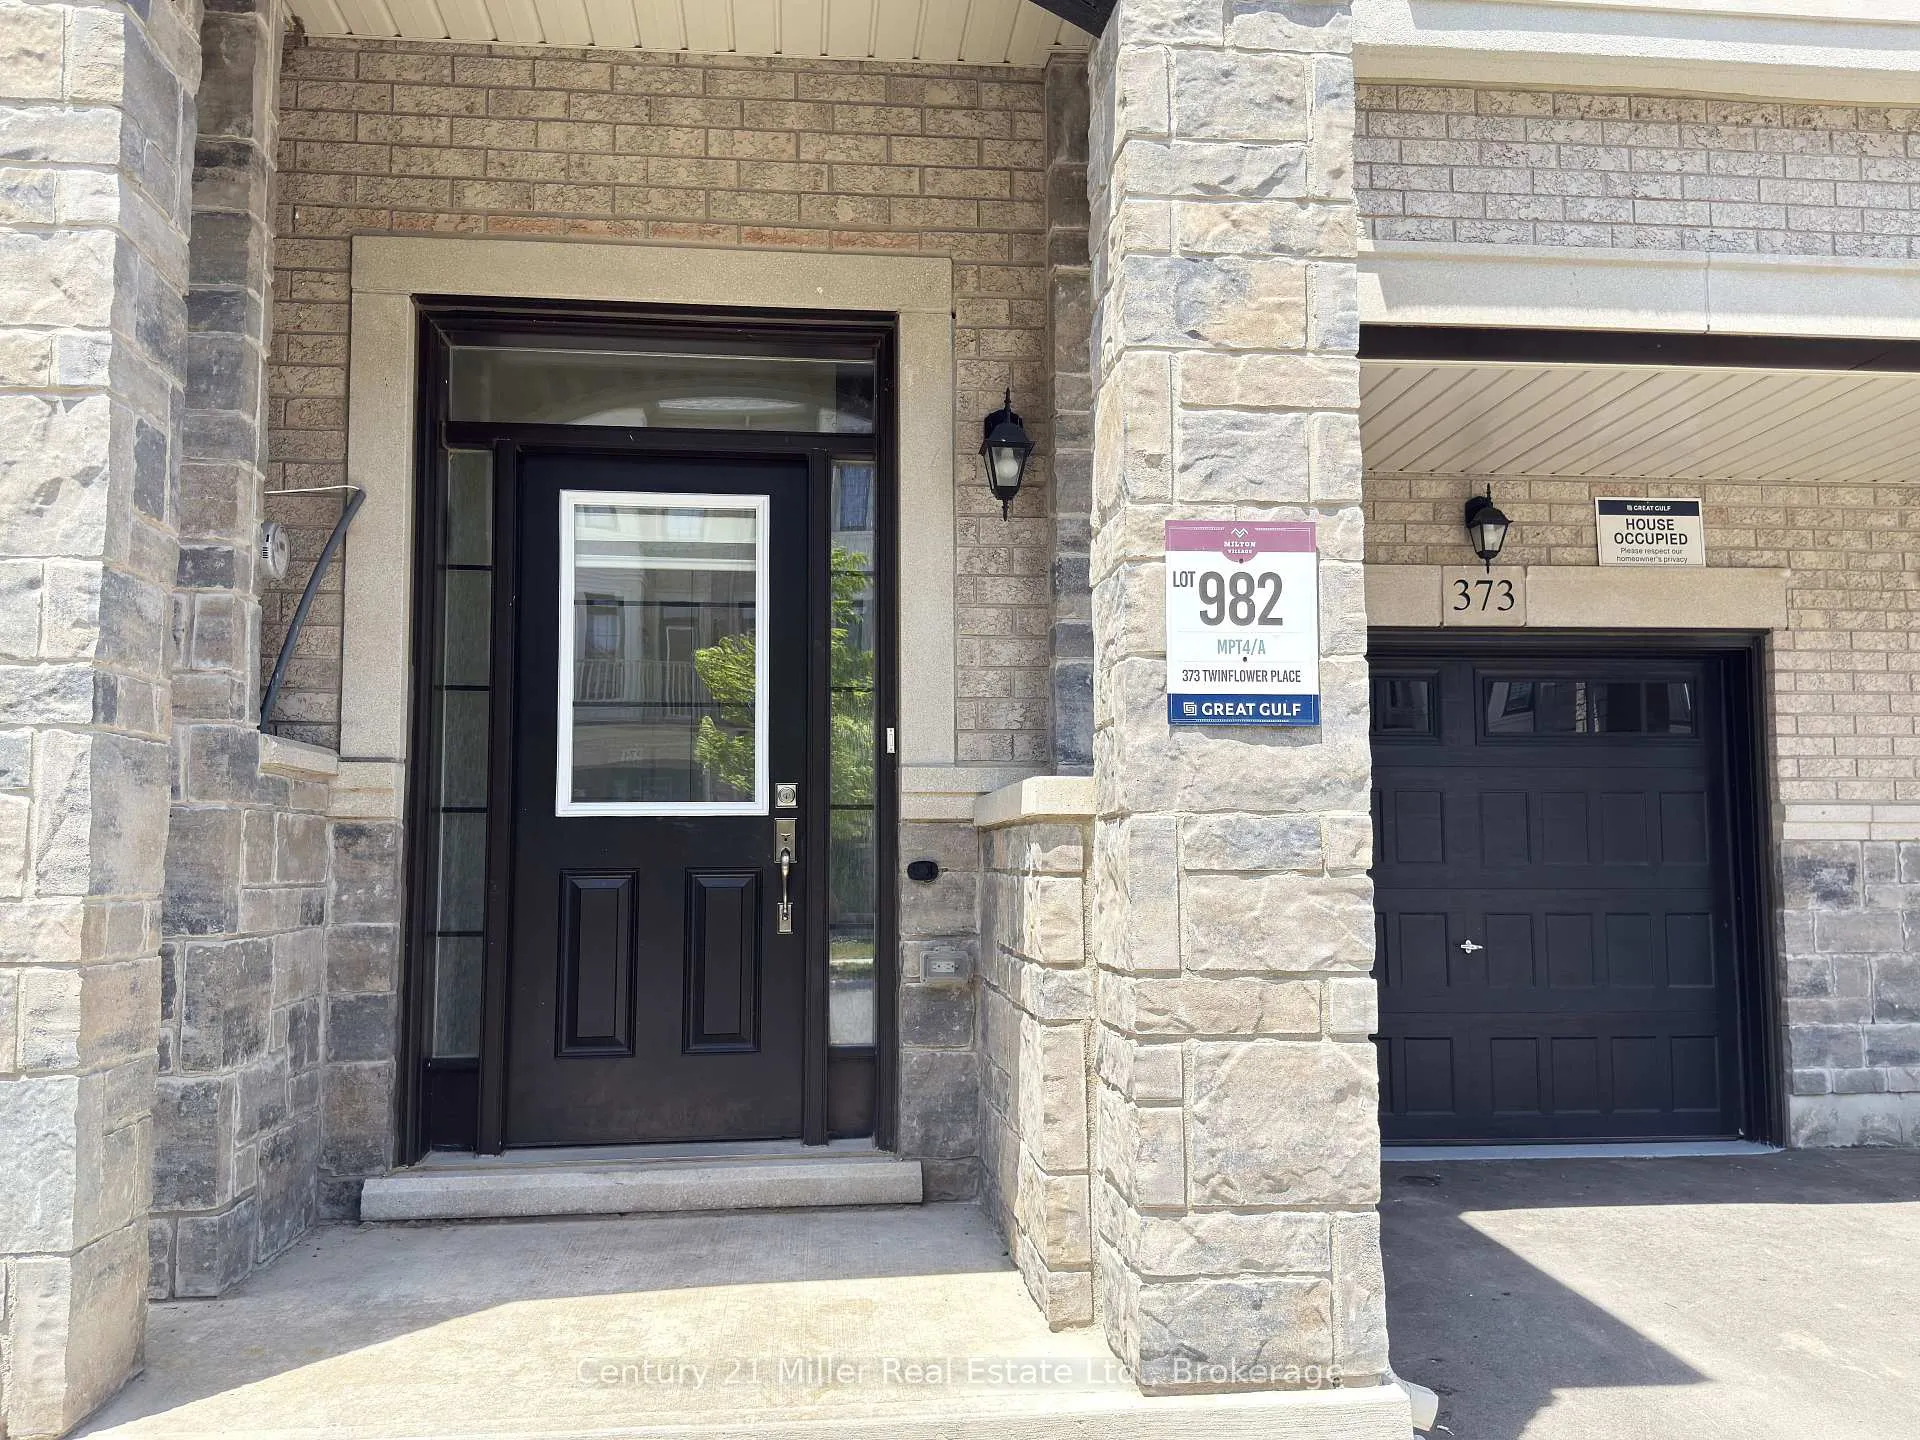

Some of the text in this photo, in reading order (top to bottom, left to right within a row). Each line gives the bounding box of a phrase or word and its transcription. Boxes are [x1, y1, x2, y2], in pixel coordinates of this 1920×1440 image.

[1626, 518, 1675, 531] HOUSE
[1614, 532, 1688, 545] OCCUPIED
[1644, 548, 1670, 556] respect
[1173, 571, 1283, 626] LOT 982
[1453, 579, 1515, 611] 373
[1217, 639, 1266, 655] MPT4/A
[1182, 669, 1301, 682] 373 TWINFLOWER PLACE
[1202, 703, 1301, 716] GREAT GULF
